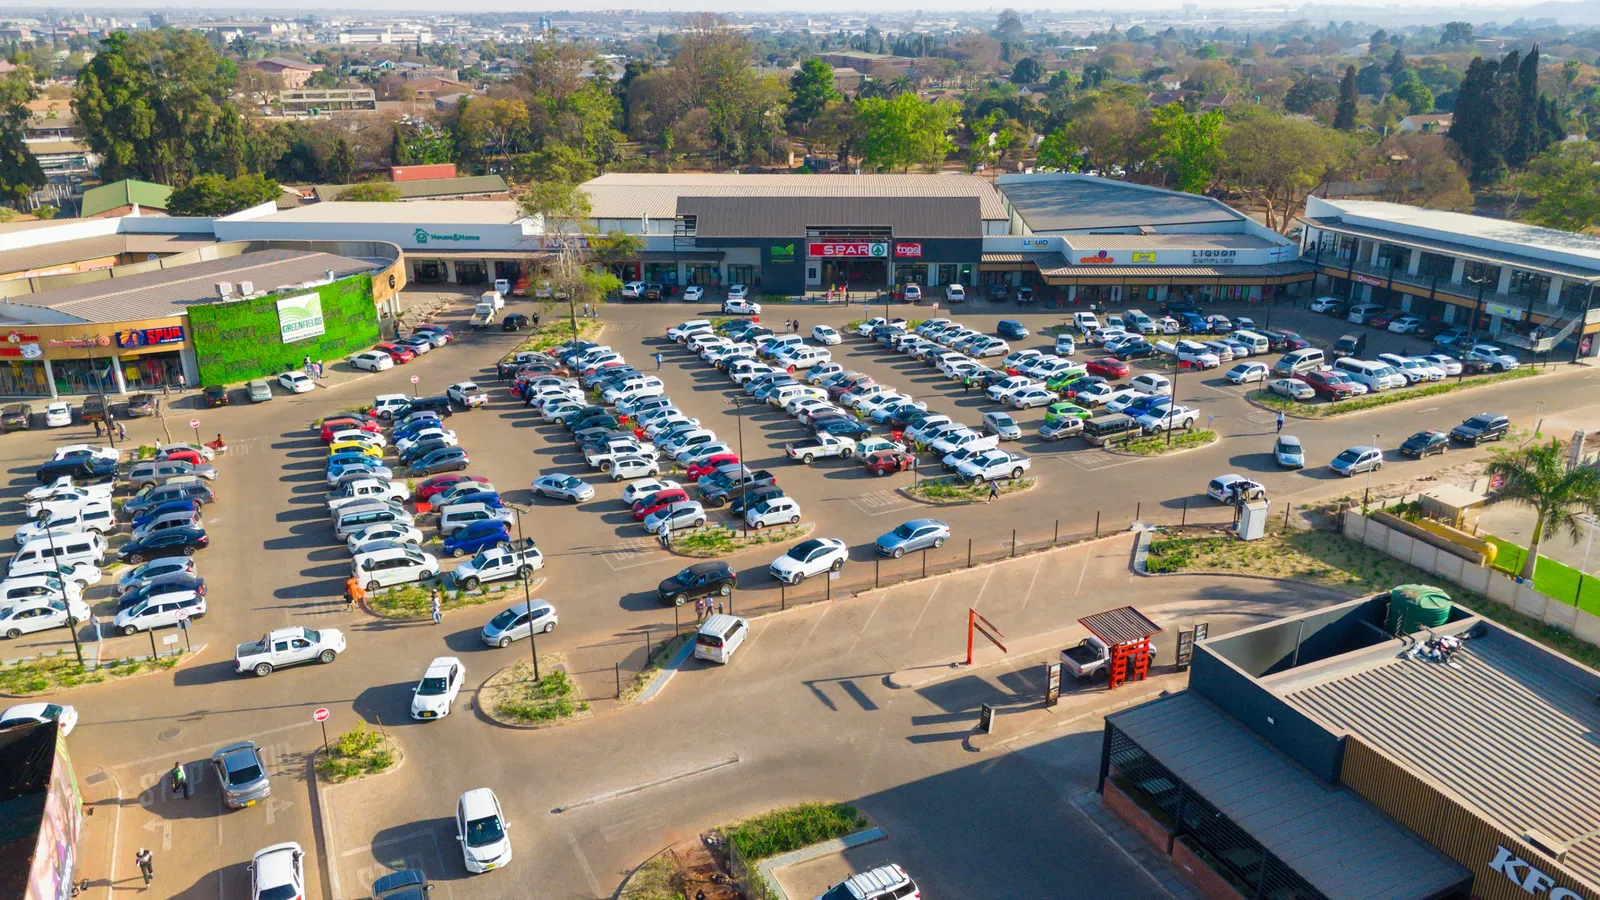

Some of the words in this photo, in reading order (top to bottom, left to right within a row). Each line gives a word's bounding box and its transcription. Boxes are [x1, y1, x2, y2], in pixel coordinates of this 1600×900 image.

[824, 246, 868, 254] SPAR
[282, 317, 322, 333] GREENFIELDS
[146, 327, 182, 345] SPUR
